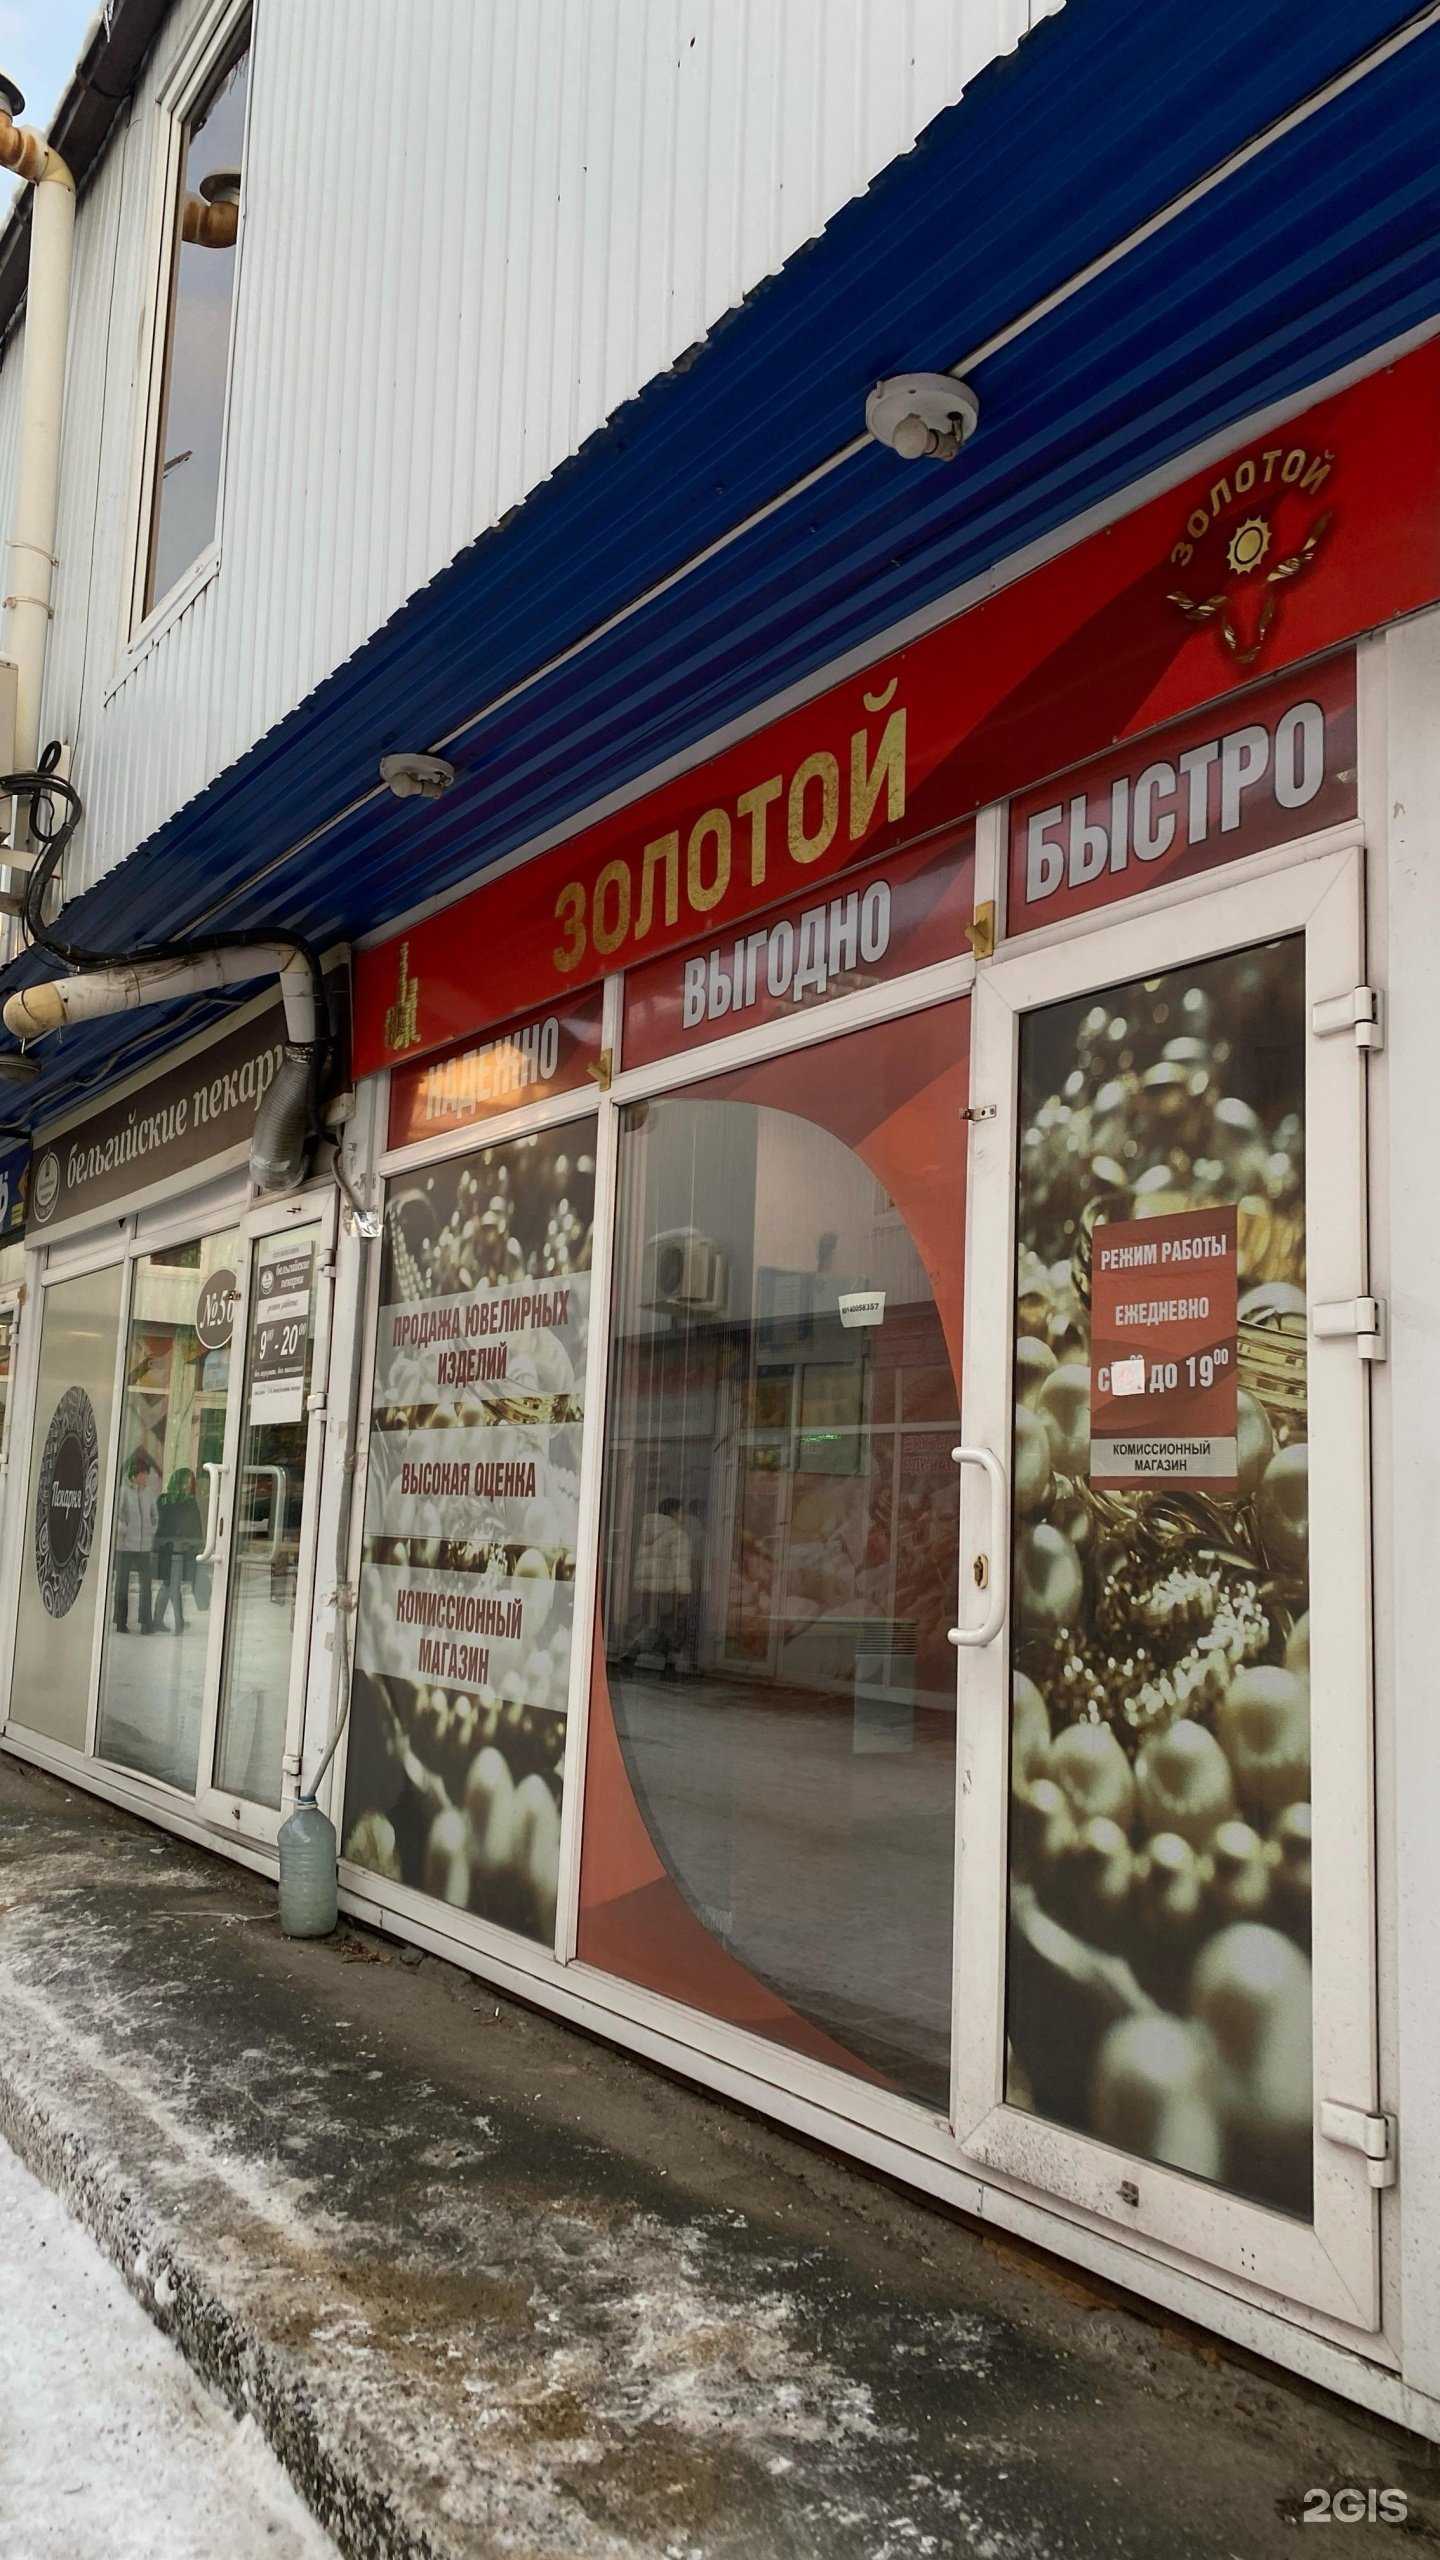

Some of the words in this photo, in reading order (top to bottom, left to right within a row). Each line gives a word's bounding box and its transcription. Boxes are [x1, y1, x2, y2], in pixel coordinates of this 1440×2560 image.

[1171, 448, 1335, 567] ЗОЛОТОЙ
[553, 677, 908, 973] ЗОЛОТОЙ
[1025, 699, 1327, 905] БЫСТРО
[682, 879, 893, 1031] ВЫГОДНО
[67, 1098, 187, 1189] бельгийские
[1101, 1243, 1157, 1271] РЕЖИМ
[1162, 1234, 1227, 1262] РАБОТЫ
[392, 1307, 460, 1349] ПРОДАЖА
[464, 1289, 570, 1338] ЮВЕЛИРНЫХ
[1115, 1297, 1209, 1327] ЕЖЕДНЕВНО
[437, 1341, 508, 1389] ИЗДЕЛИЙ
[1113, 1440, 1211, 1456] КОМИССИОННЫЙ
[1134, 1459, 1188, 1472] МАГАЗИН
[51, 1480, 82, 1520] Пекарня
[401, 1462, 471, 1497] ВЫСОКАЯ
[474, 1462, 537, 1502] ОЦЕНКА
[396, 1588, 523, 1640] КОМИССИОННЫЙ
[418, 1638, 490, 1685] МАГАЗИН
